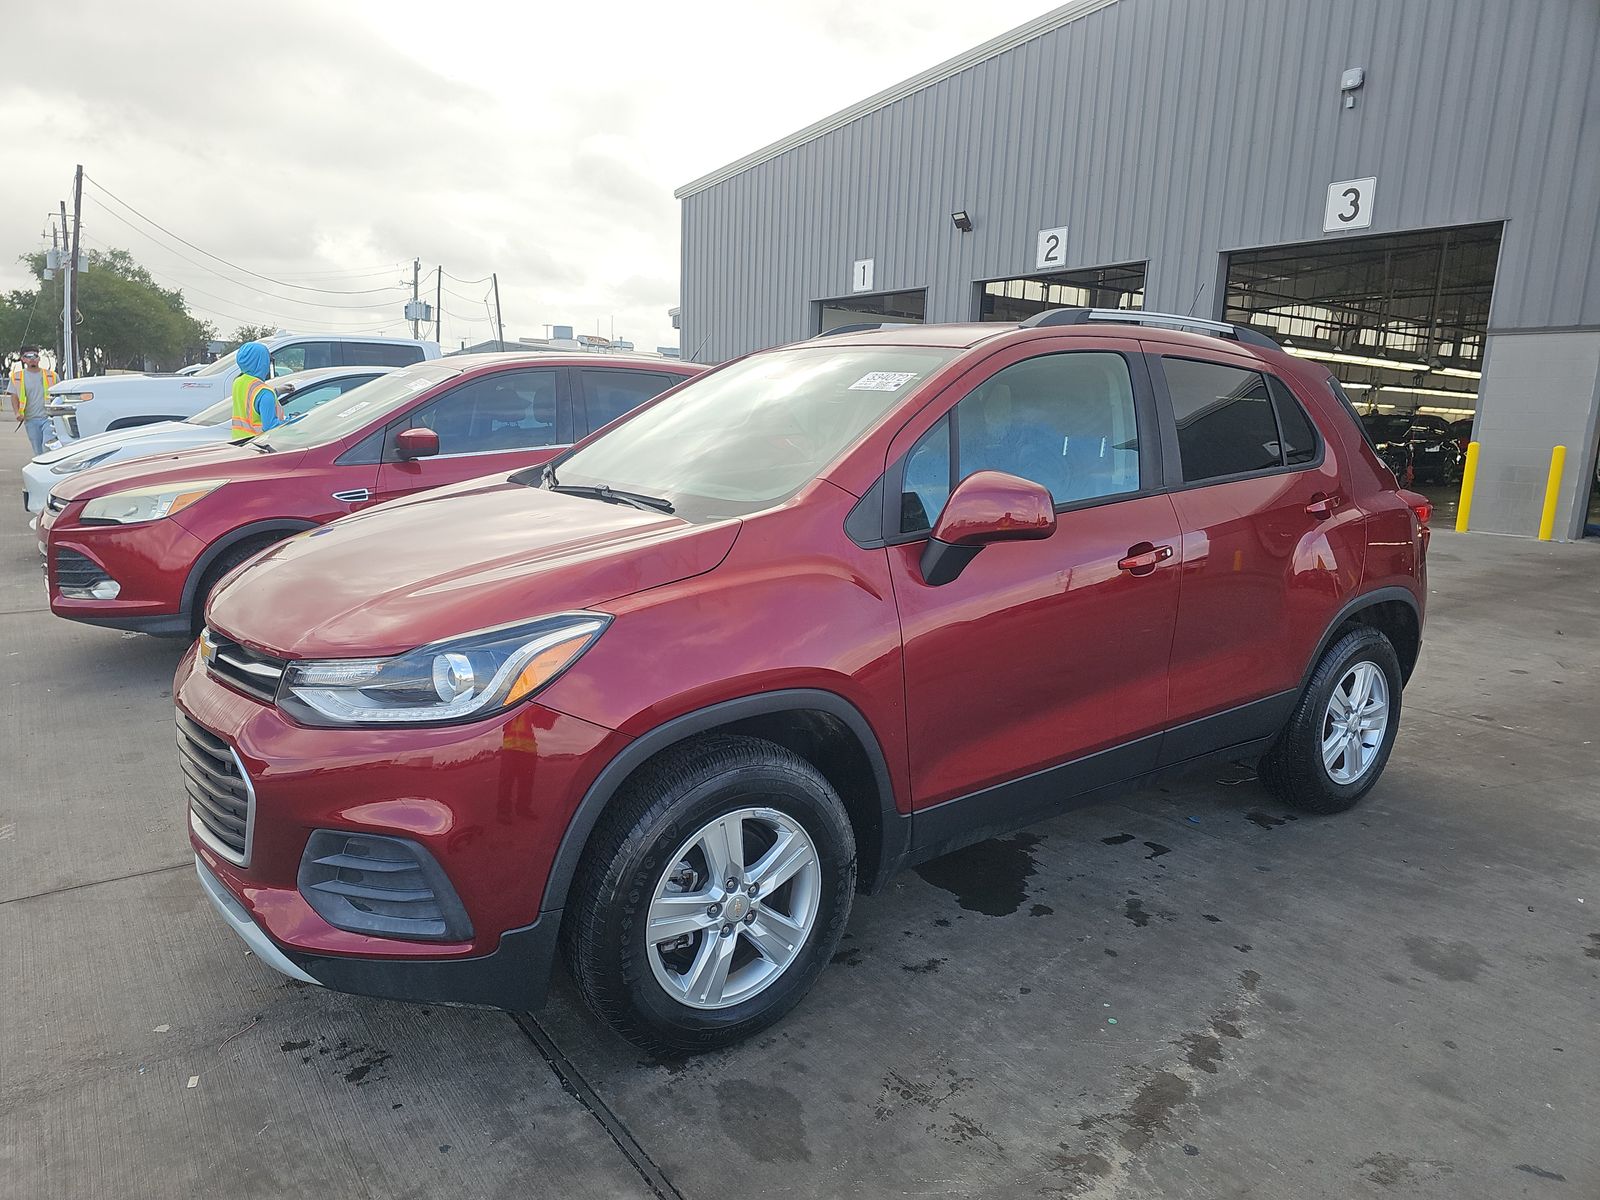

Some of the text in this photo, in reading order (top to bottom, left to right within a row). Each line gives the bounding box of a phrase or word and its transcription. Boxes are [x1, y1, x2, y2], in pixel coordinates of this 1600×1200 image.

[1336, 187, 1361, 223] 3
[1044, 234, 1060, 262] 2
[861, 264, 866, 287] 1
